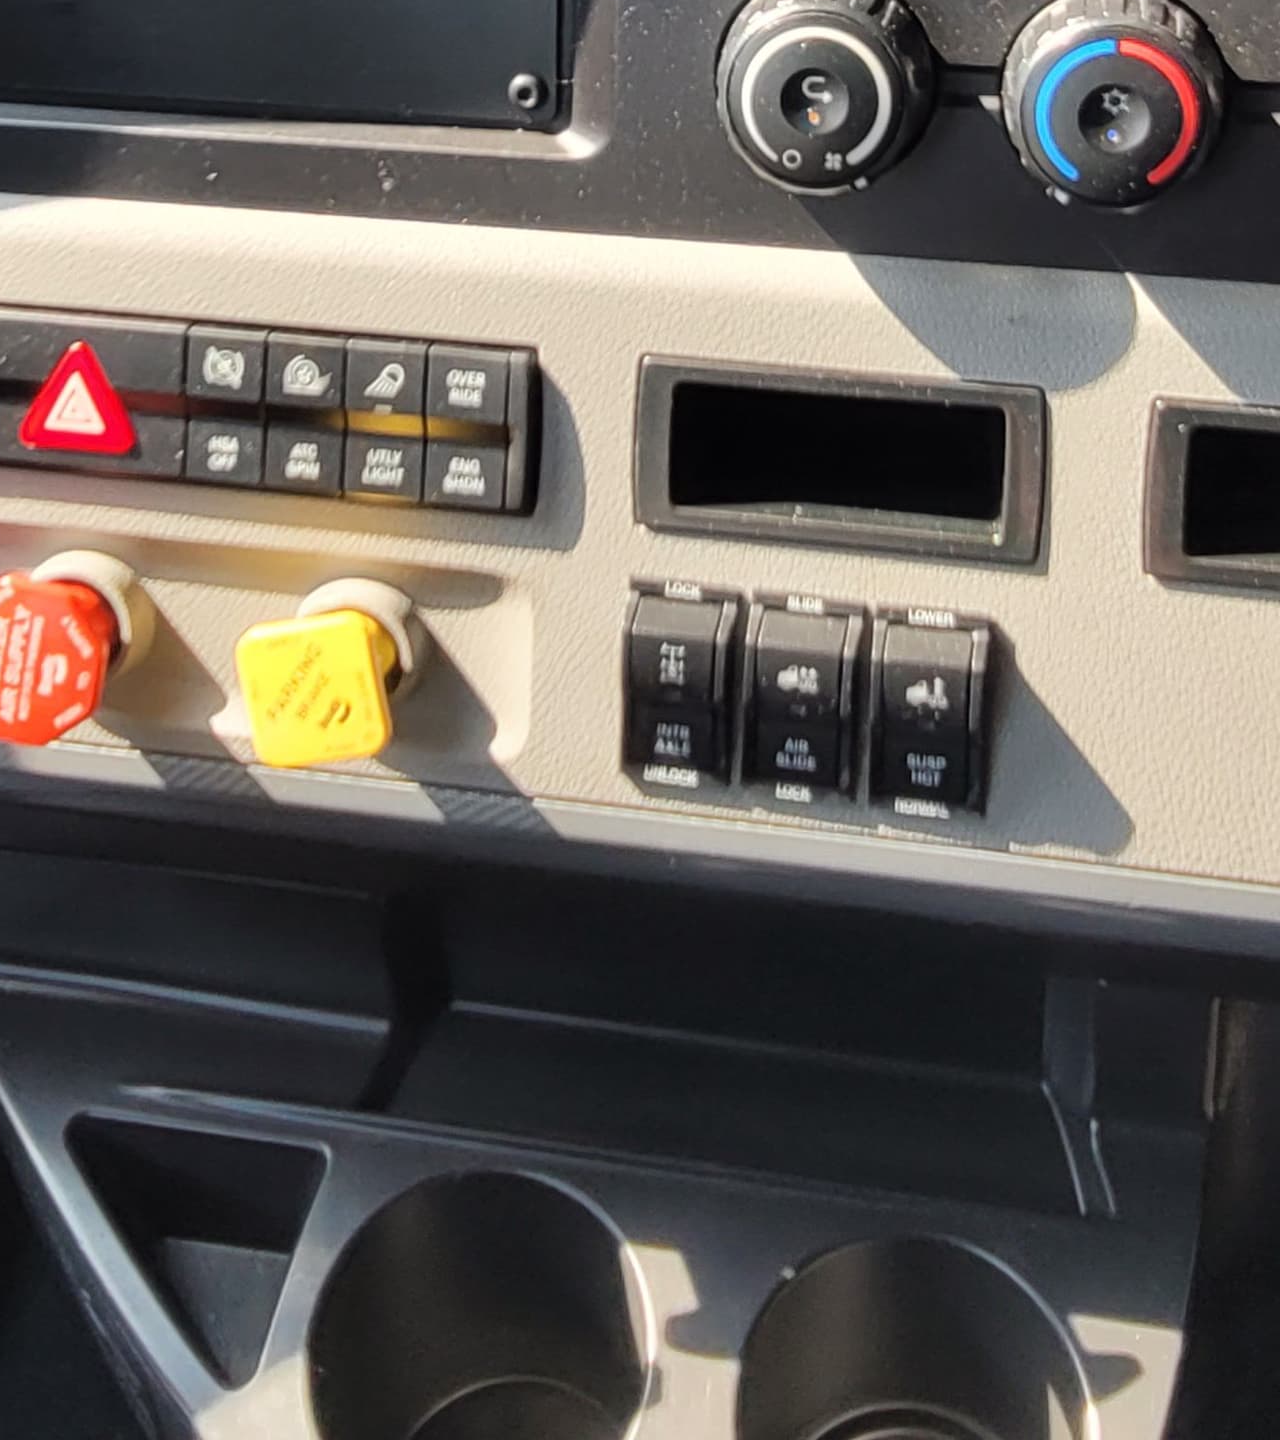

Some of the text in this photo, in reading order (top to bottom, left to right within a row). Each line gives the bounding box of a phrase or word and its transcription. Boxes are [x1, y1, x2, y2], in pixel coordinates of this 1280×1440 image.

[445, 367, 486, 389] OVER
[447, 387, 483, 408] RIDE
[206, 452, 238, 473] OFF
[366, 446, 403, 467] UTLY
[449, 455, 482, 477] ENG
[284, 460, 321, 481] SPIN
[361, 464, 406, 488] LIGHT
[442, 474, 486, 497] SHDN
[664, 579, 703, 602] LOCK
[786, 595, 824, 616] SLIDE
[907, 607, 958, 630] LOWER
[653, 737, 692, 759] AXLE
[784, 736, 809, 755] AIR
[775, 751, 818, 773] SLIDE
[906, 752, 947, 772] SUSP
[643, 762, 700, 790] UNLOCK
[775, 781, 813, 804] LOCK
[893, 797, 951, 820] NORMAL
